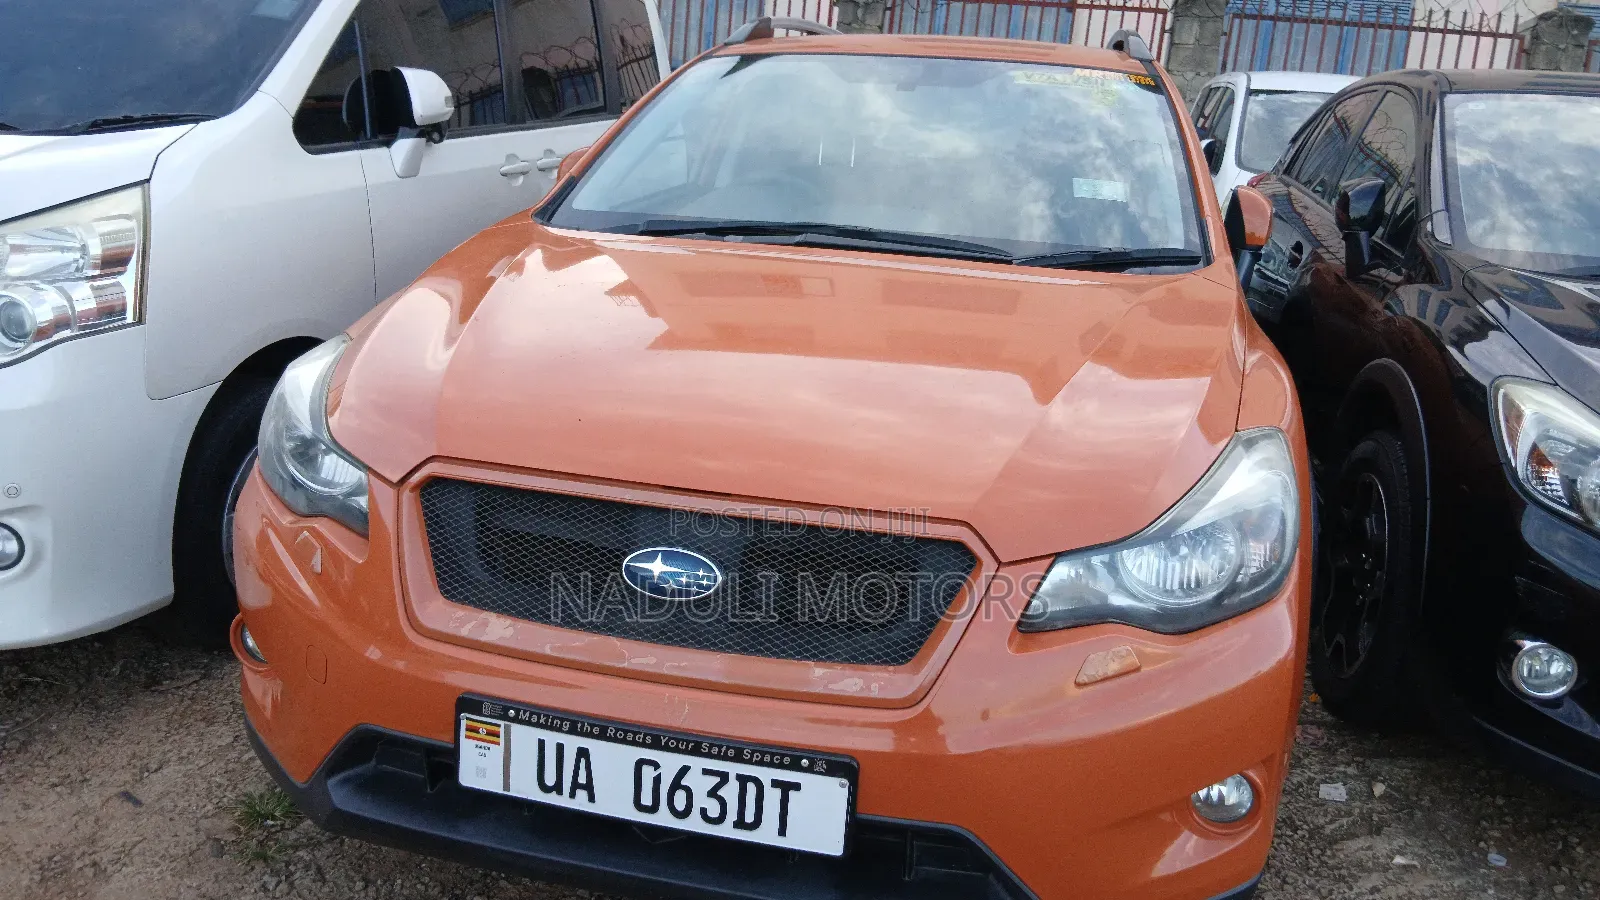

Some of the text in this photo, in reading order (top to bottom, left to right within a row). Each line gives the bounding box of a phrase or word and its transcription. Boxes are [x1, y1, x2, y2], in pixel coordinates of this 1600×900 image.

[518, 709, 571, 731] Making
[577, 721, 600, 735] the
[606, 726, 652, 744] Roads
[660, 735, 694, 751] Your
[701, 742, 735, 757] Safe
[742, 749, 791, 765] Space
[536, 737, 802, 837] UA 063DT
